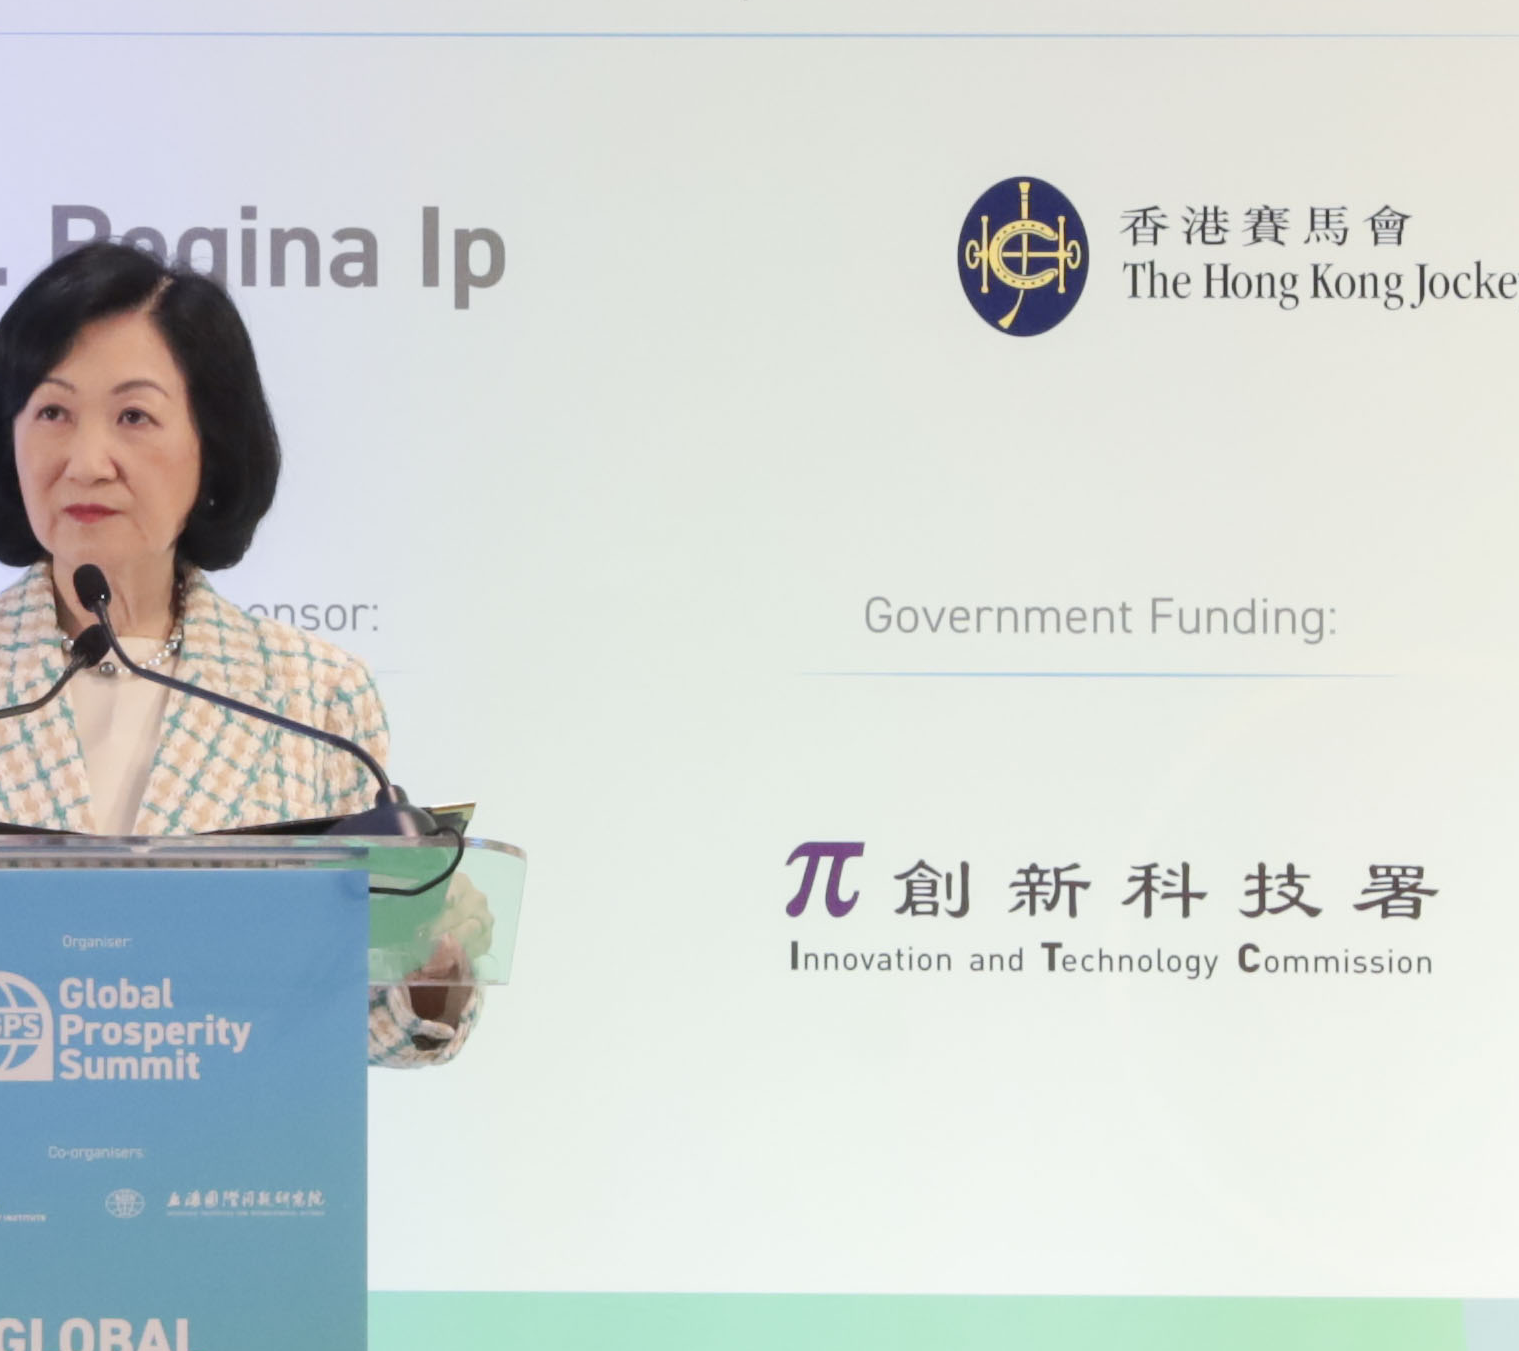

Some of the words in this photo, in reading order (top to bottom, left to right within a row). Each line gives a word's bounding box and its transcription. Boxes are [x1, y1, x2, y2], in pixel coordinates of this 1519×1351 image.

[1121, 205, 1410, 246] 香港賽馬會
[423, 206, 505, 309] Ip
[1124, 260, 1191, 298] The
[1205, 264, 1299, 309] Hong
[1312, 264, 1403, 309] Kong
[865, 596, 1132, 634] Government
[1152, 597, 1335, 645] Funding:
[894, 860, 1438, 920] 創新科技署
[791, 941, 951, 971] Innovation
[970, 948, 1023, 971] and
[1041, 942, 1218, 979] Technology
[1238, 943, 1431, 974] Commission
[59, 978, 173, 1009] Global
[59, 1014, 251, 1051] Prosperity
[59, 1049, 201, 1081] Summit
